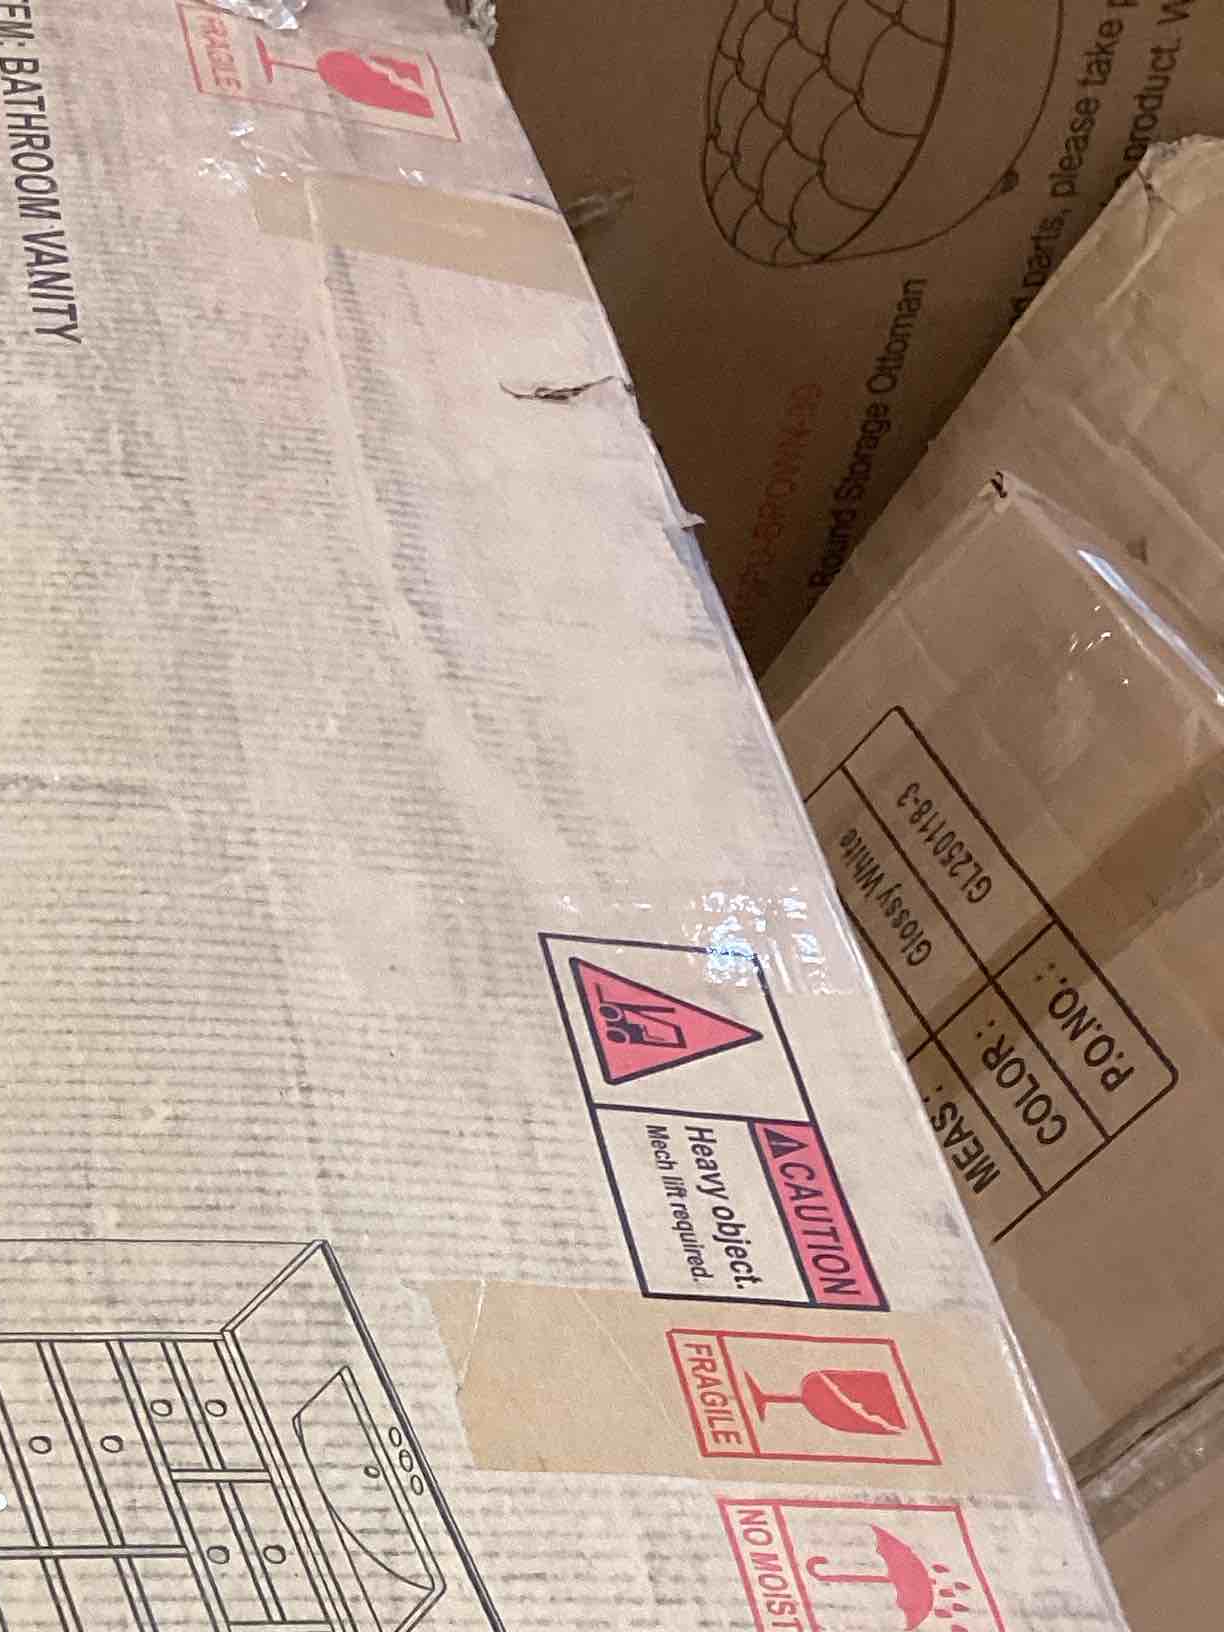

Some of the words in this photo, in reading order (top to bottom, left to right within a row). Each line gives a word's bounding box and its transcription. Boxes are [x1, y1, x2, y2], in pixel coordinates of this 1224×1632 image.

[1048, 97, 1101, 198] please
[1077, 18, 1124, 87] take
[22, 229, 82, 345] VANITY
[866, 278, 927, 394] Ottoman
[840, 828, 885, 898] White
[897, 782, 993, 904] GL250118-3
[878, 883, 933, 966] Glossy
[646, 1125, 679, 1171] Mech
[662, 1176, 688, 1200] lift
[672, 1202, 715, 1283] required.
[684, 1126, 726, 1199] Heavy
[713, 1206, 762, 1290] object.
[780, 1162, 861, 1296] CAUTION
[684, 1343, 743, 1445] FRAGILE
[737, 1509, 773, 1546] NO
[749, 1551, 804, 1632] MOIST
